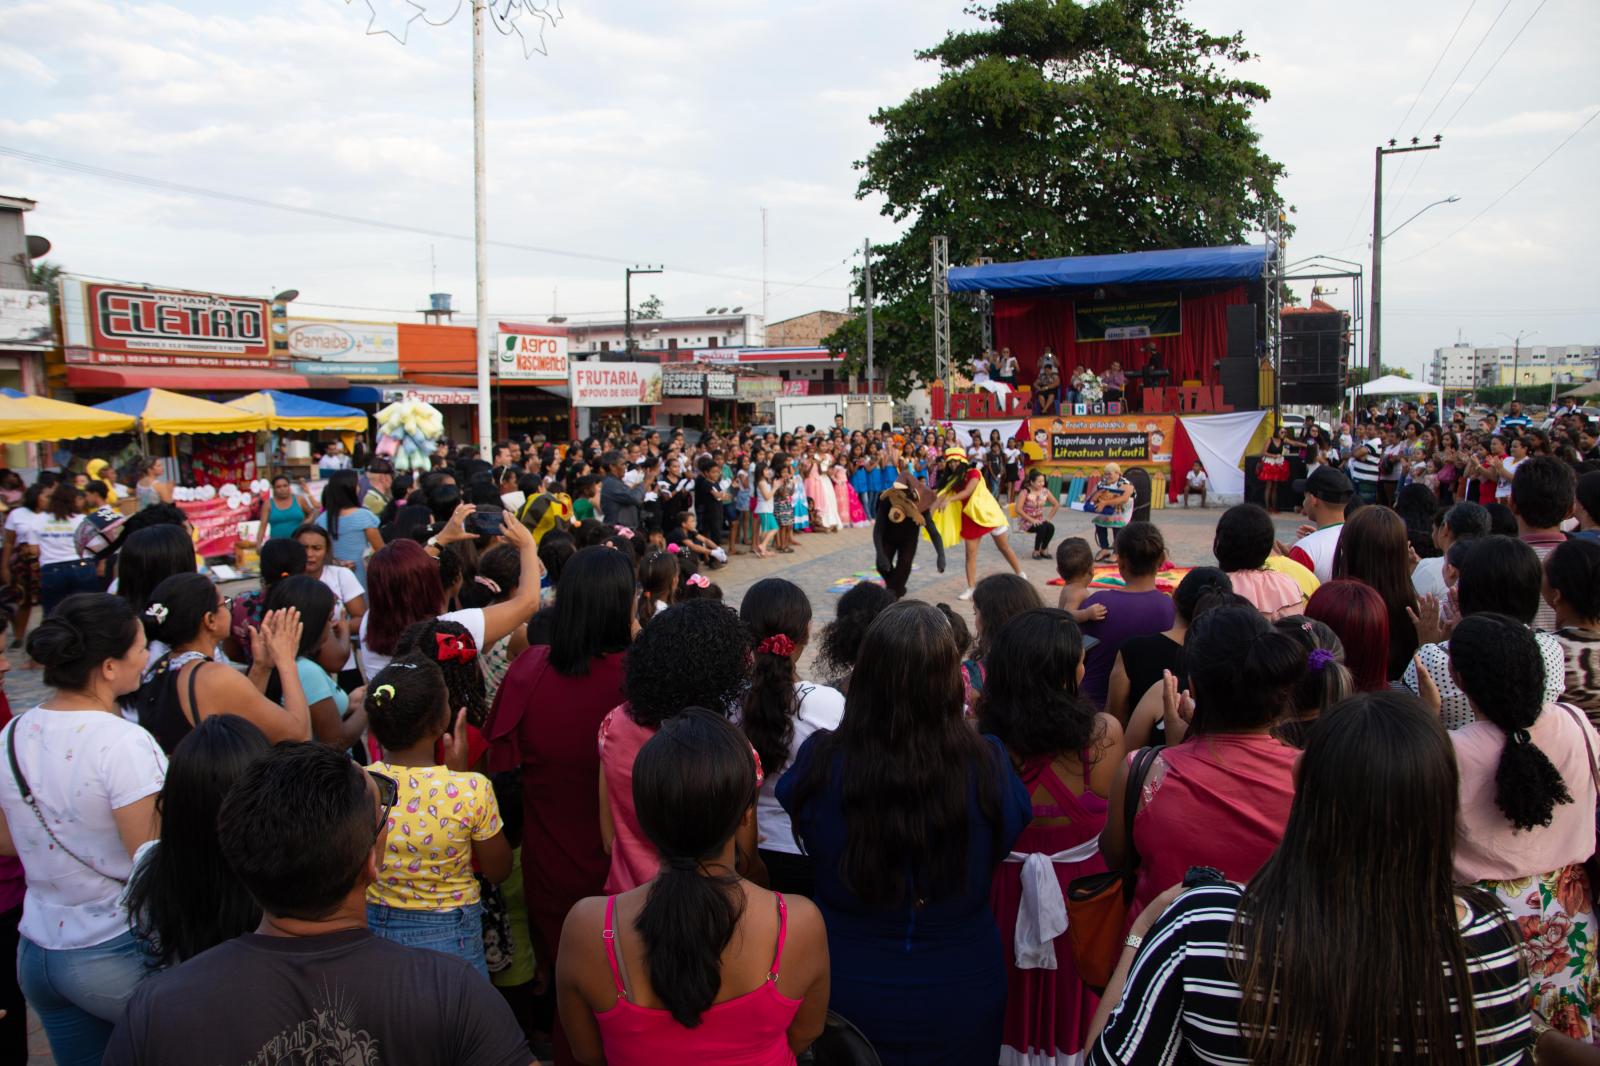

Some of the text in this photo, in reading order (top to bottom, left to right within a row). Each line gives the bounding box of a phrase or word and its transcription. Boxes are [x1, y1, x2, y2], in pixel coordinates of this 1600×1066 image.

[98, 290, 265, 344] ELETRO
[521, 335, 557, 353] Agro
[576, 369, 639, 385] FRUTARIA
[588, 389, 608, 397] POVO
[609, 389, 619, 397] DE
[951, 385, 1235, 419] FELIZ NATAL
[1054, 436, 1096, 446] Despertando
[1105, 437, 1128, 447] prazer
[1130, 435, 1145, 445] pela
[1054, 448, 1104, 458] Literatura
[1108, 446, 1146, 458] Infantil
